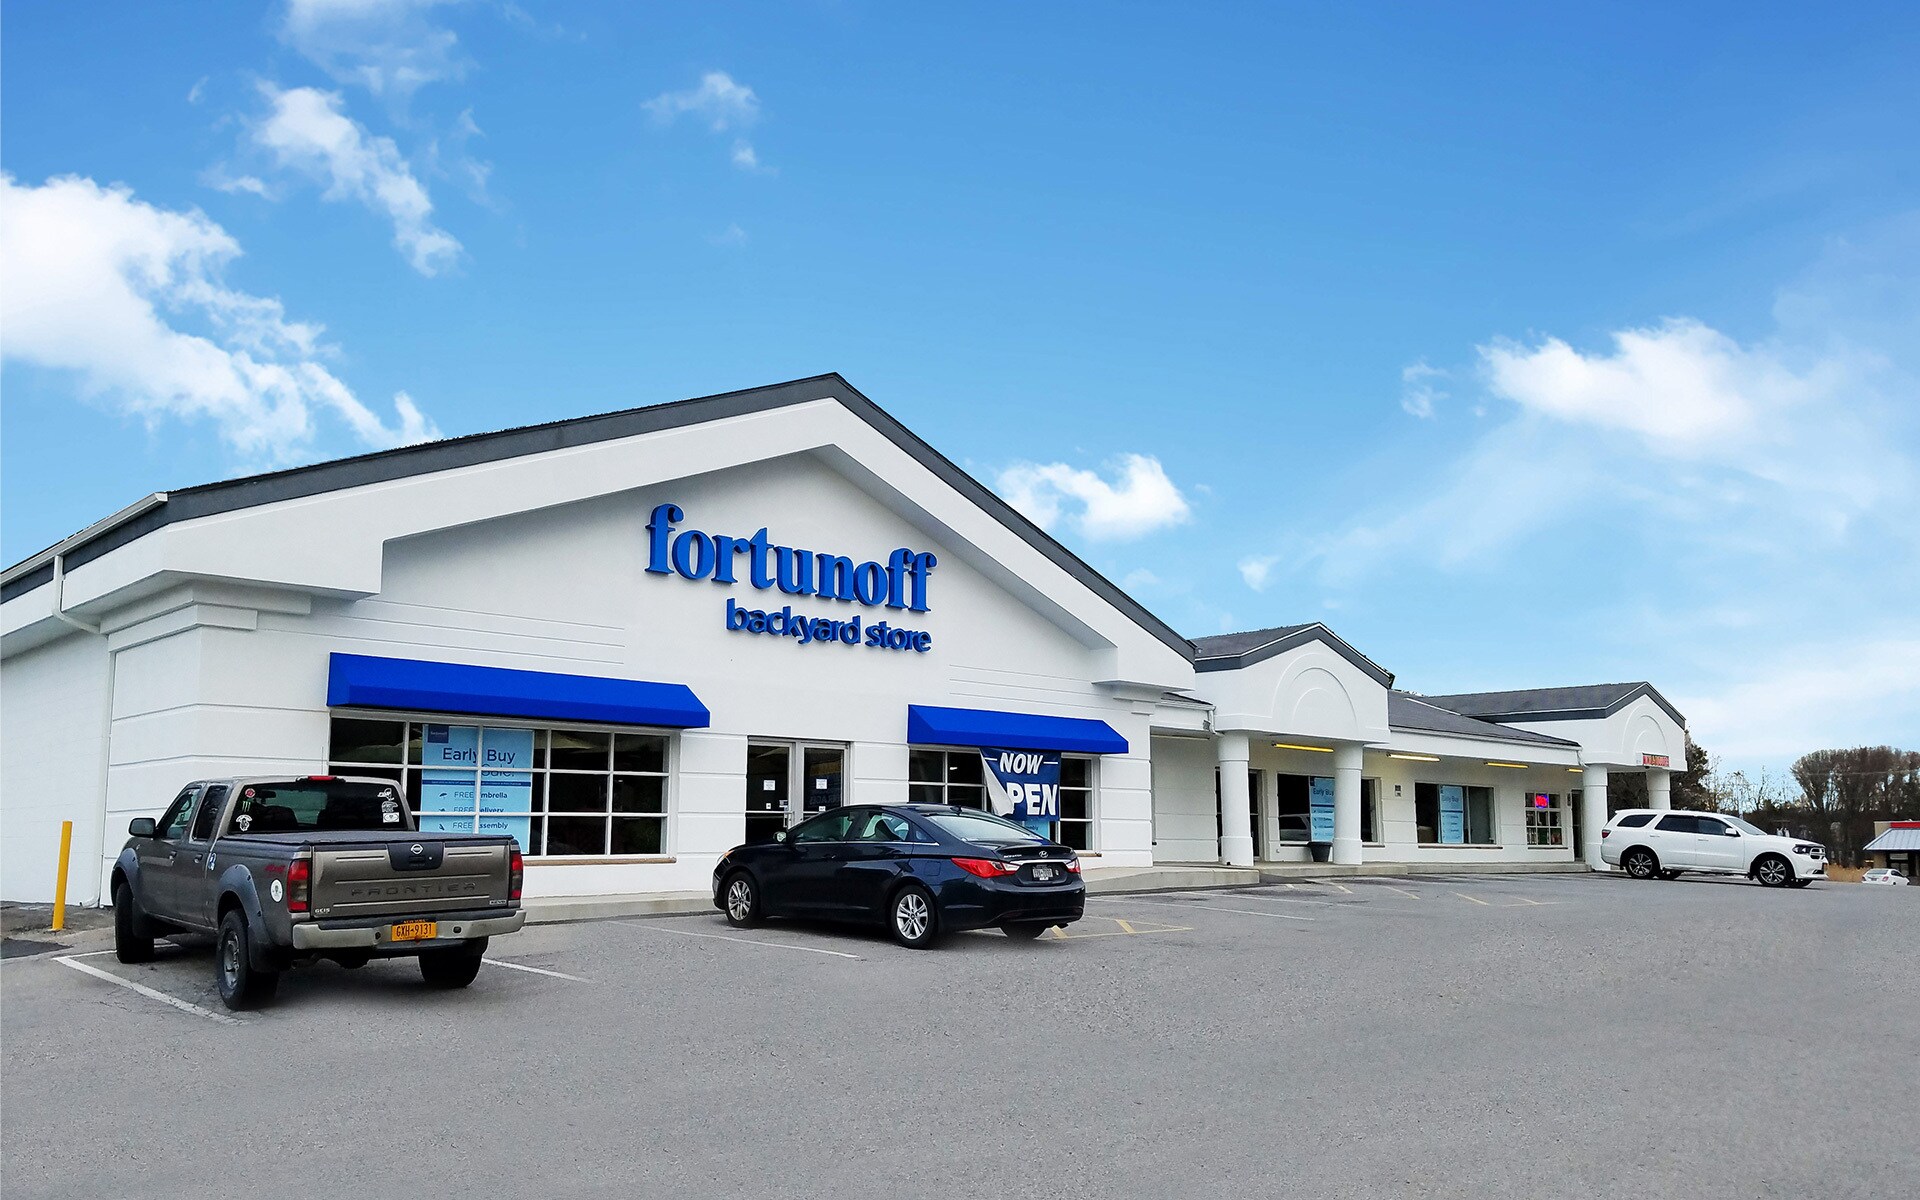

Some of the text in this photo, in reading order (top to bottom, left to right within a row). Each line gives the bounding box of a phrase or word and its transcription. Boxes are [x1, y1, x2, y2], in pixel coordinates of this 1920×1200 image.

[645, 503, 937, 612] fortunoff
[726, 598, 932, 653] backyard store
[487, 749, 516, 764] Buy
[999, 752, 1043, 775] NOW
[454, 791, 508, 799] FREE mbrella
[1005, 782, 1058, 816] PEN
[452, 822, 508, 830] FREE ssembly
[351, 882, 476, 897] FRONTIER
